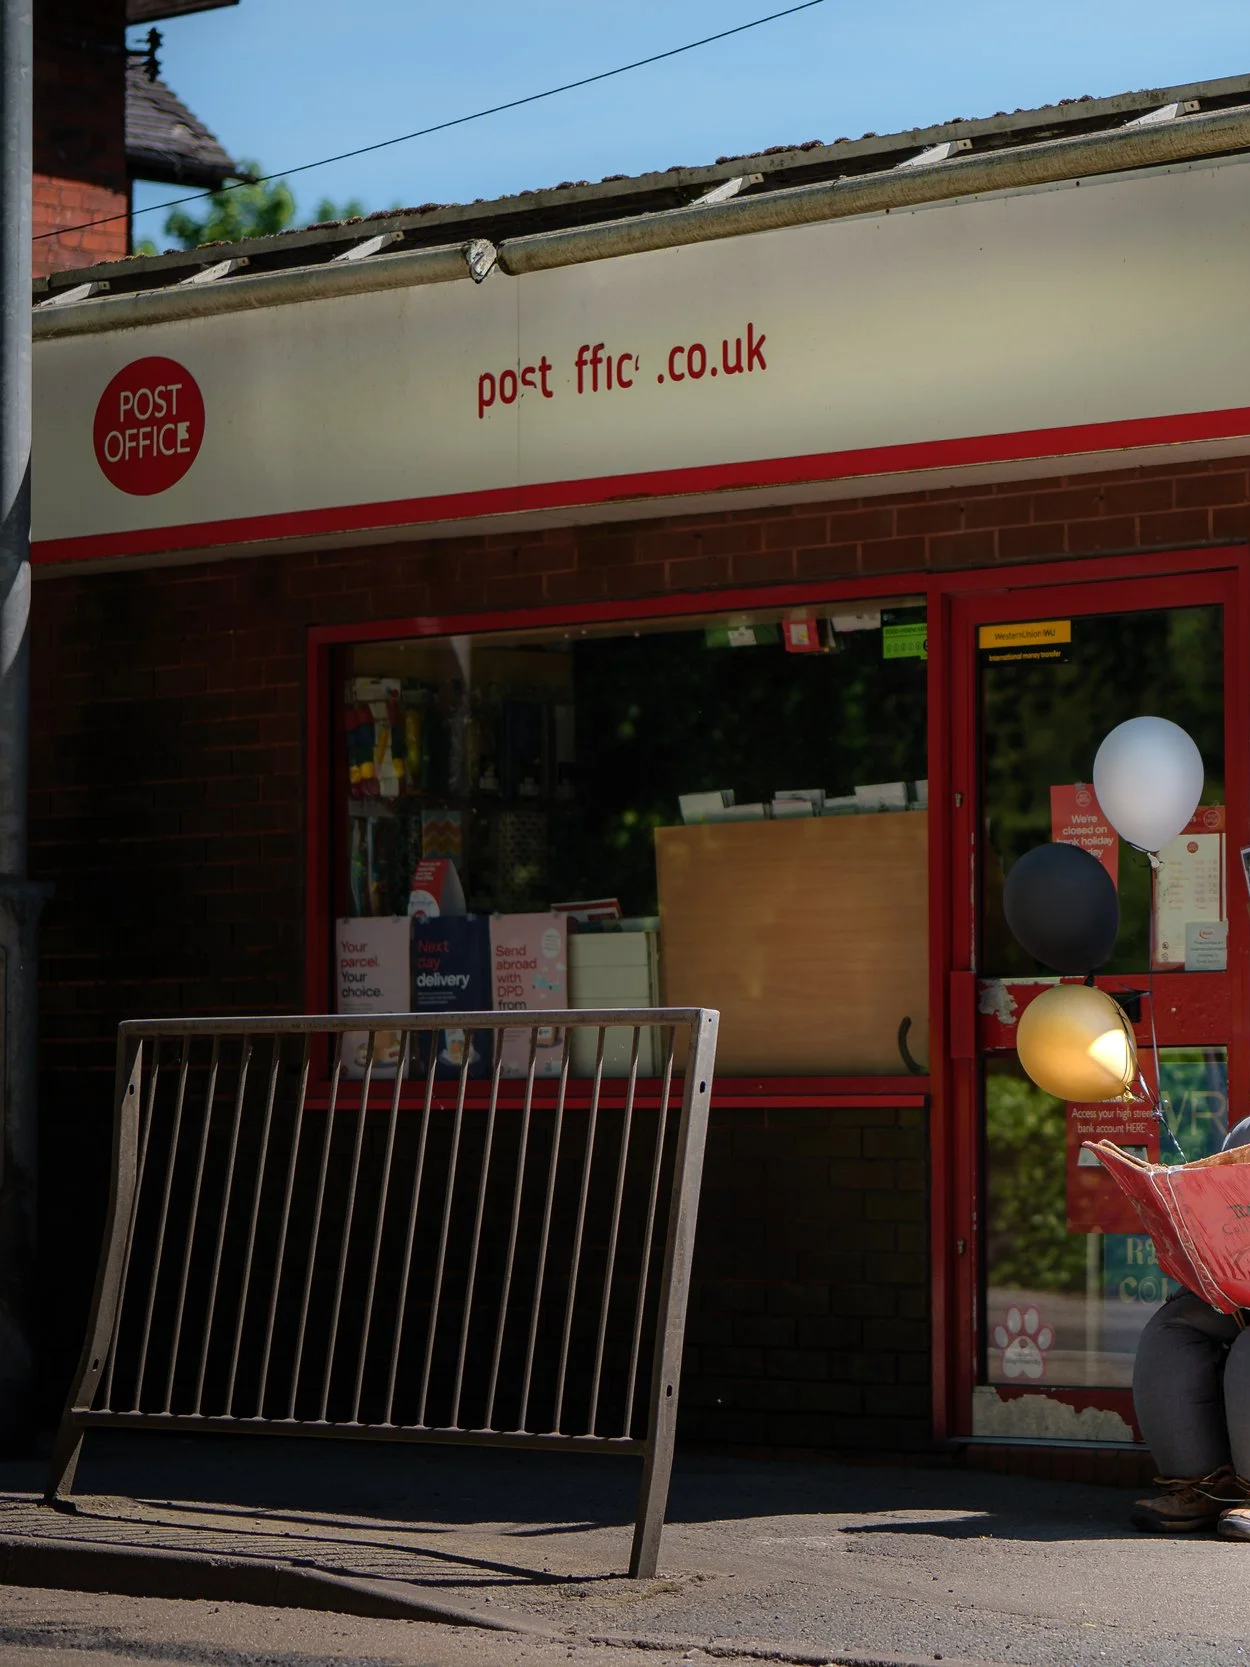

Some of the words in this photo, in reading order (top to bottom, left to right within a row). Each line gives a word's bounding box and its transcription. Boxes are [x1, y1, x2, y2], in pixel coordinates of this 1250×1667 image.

[120, 383, 183, 423] POST
[104, 421, 191, 463] OFFICE
[1071, 814, 1098, 824] We're
[1062, 825, 1093, 836] closed
[1094, 826, 1108, 835] on
[1081, 835, 1114, 847] holiday
[340, 940, 368, 953] Your
[416, 939, 449, 953] Next
[495, 945, 527, 957] Send
[416, 956, 441, 970] day
[496, 958, 538, 970] abroad
[341, 970, 368, 983] Your
[416, 971, 471, 990] delivery
[496, 972, 522, 983] with
[341, 986, 385, 998] choice.
[497, 985, 524, 998] DPD
[497, 999, 528, 1011] from
[1071, 1107, 1097, 1119] Access
[1098, 1109, 1115, 1122] your
[1116, 1106, 1133, 1122] high
[1077, 1122, 1095, 1134] bank
[1096, 1123, 1125, 1134] account
